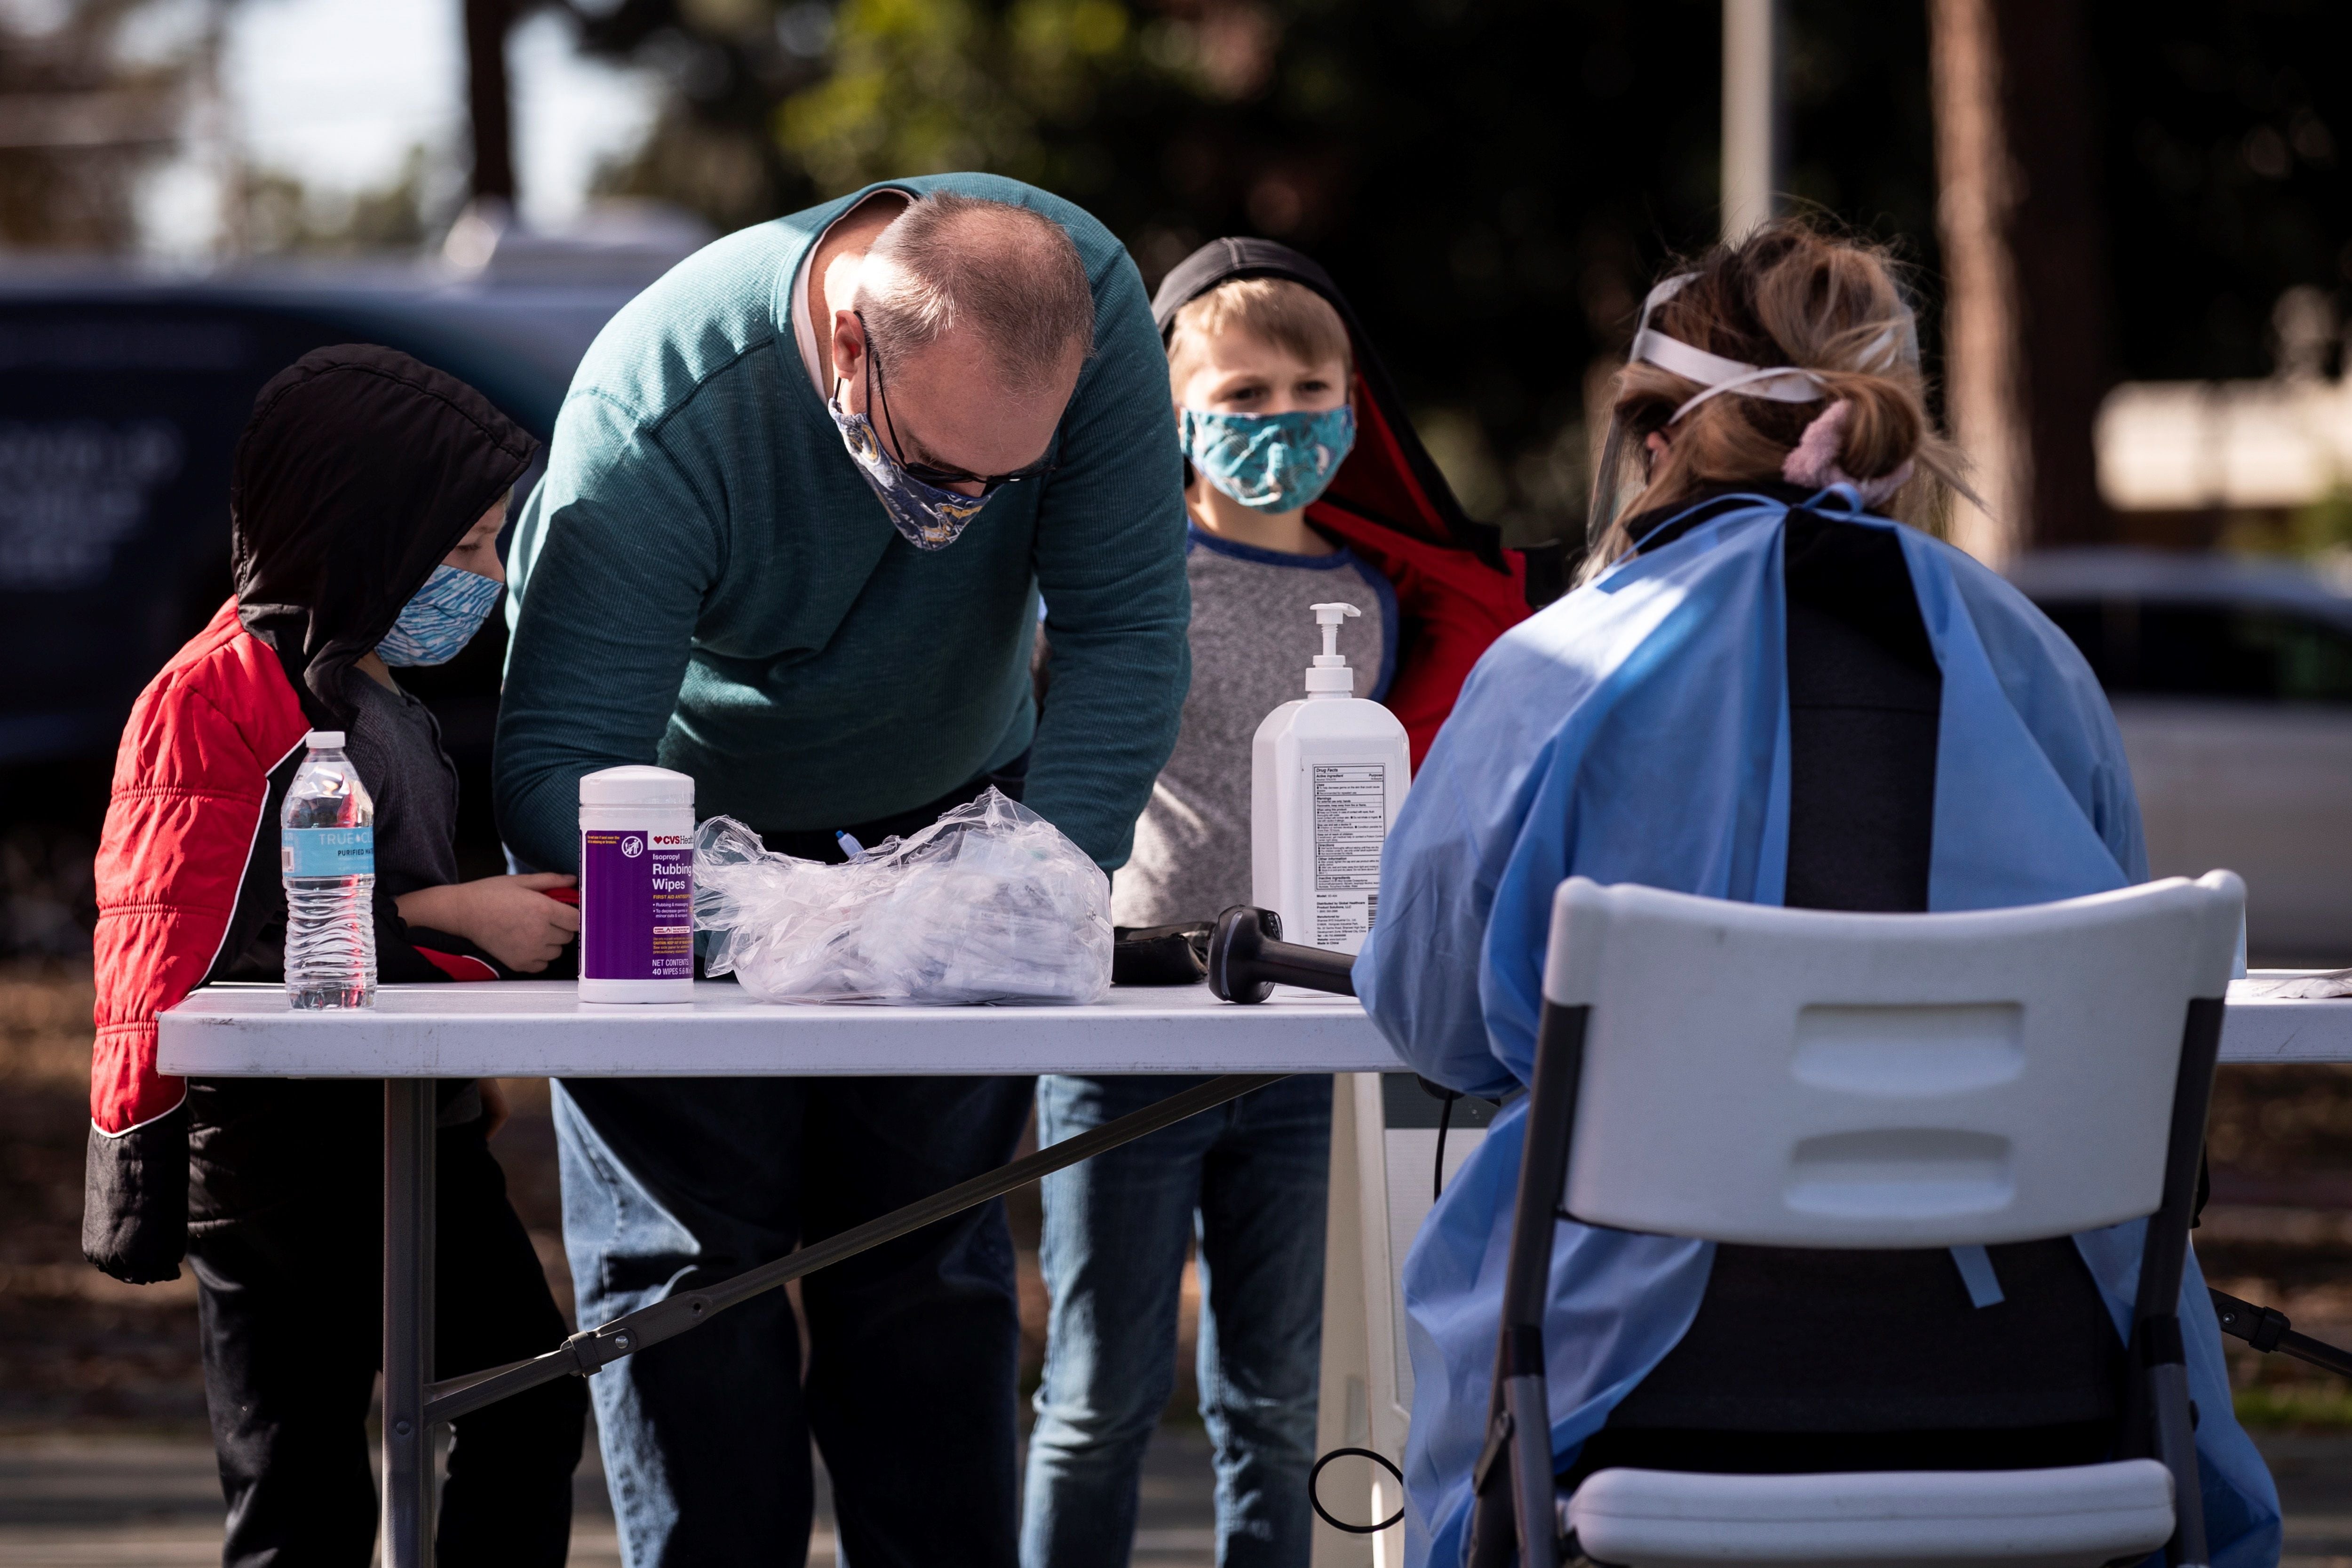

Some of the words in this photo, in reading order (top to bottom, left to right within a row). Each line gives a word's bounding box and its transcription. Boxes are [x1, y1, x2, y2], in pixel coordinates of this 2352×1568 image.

[319, 833, 354, 845] TRUE
[653, 863, 691, 877] Rubbing
[652, 878, 685, 892] Wipes
